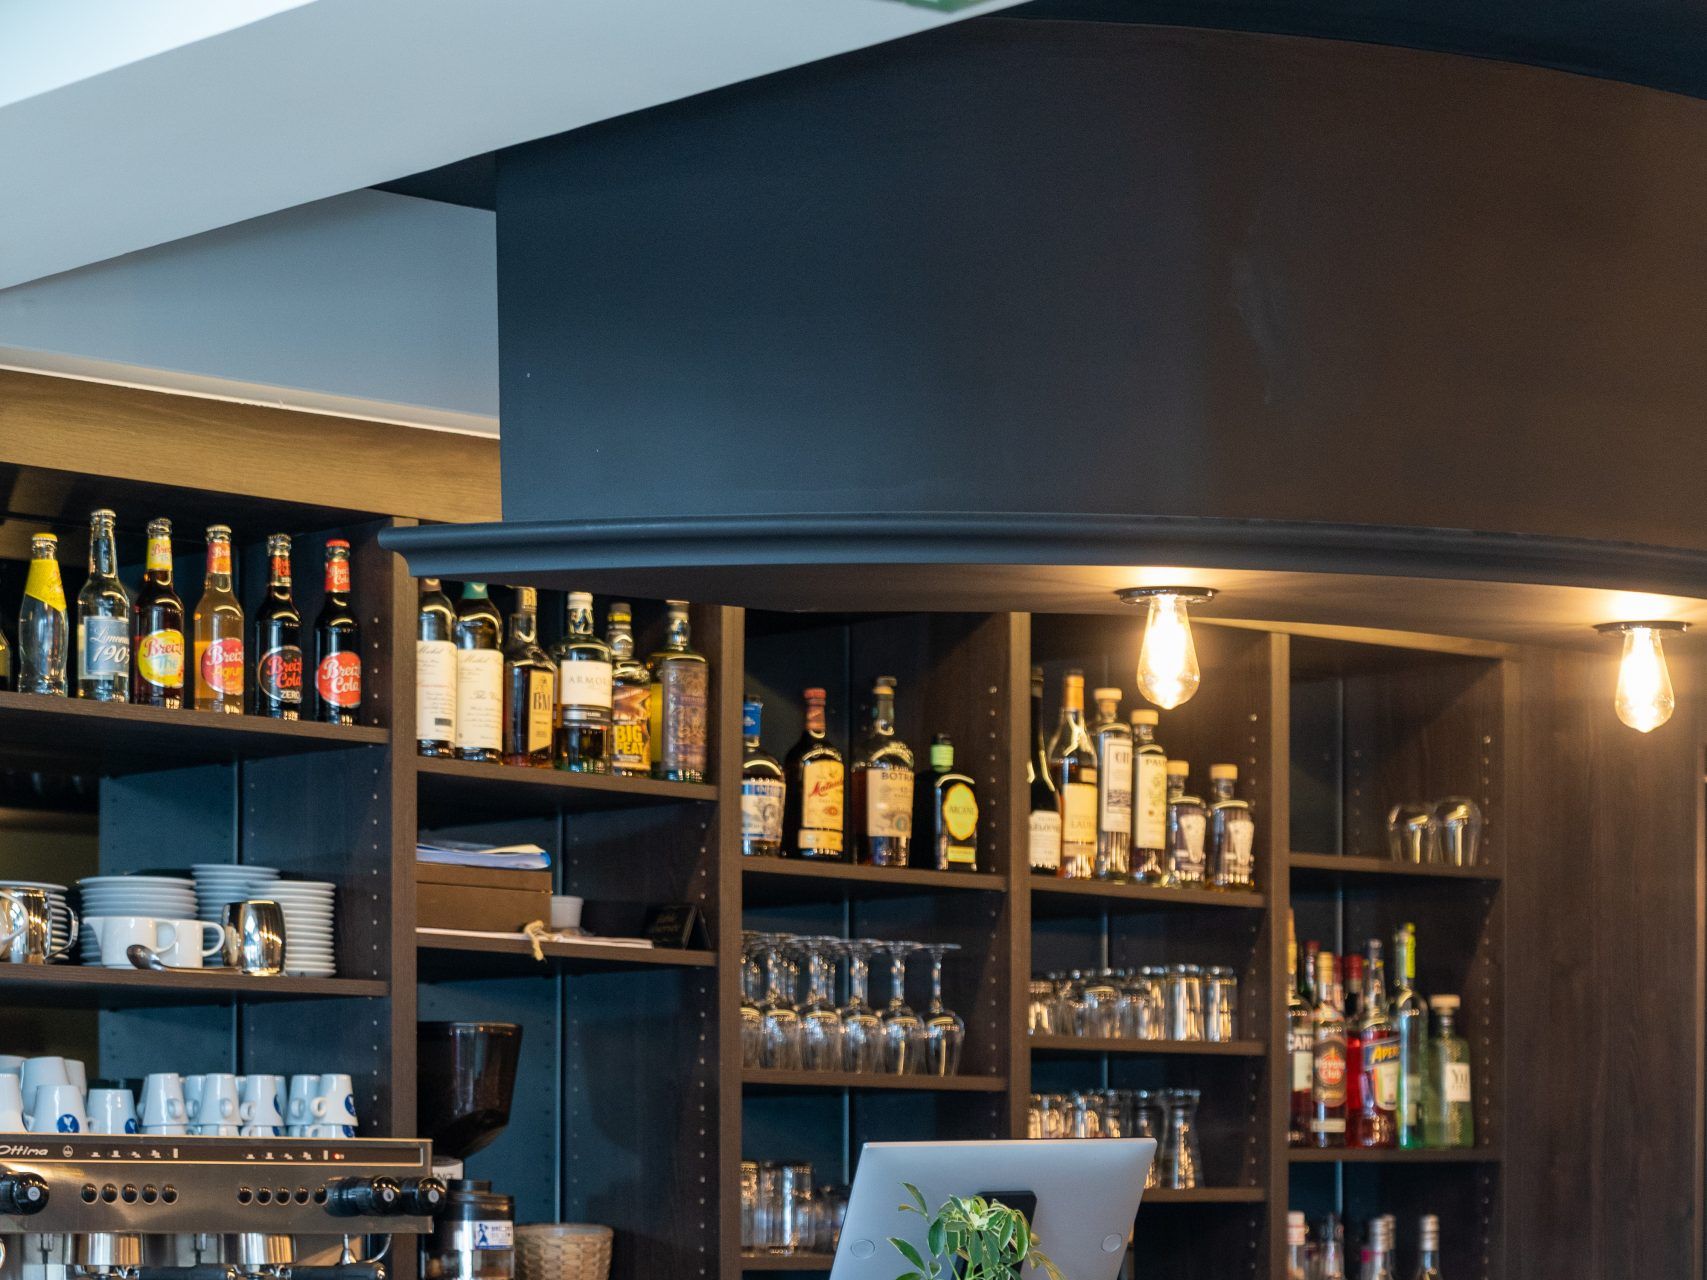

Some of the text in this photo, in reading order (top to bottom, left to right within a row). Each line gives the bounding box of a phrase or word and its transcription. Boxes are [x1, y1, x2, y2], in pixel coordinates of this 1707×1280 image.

[331, 675, 359, 694] Cola
[617, 724, 643, 743] BIG
[616, 741, 645, 755] PEAT
[0, 1145, 48, 1156] Ottima
